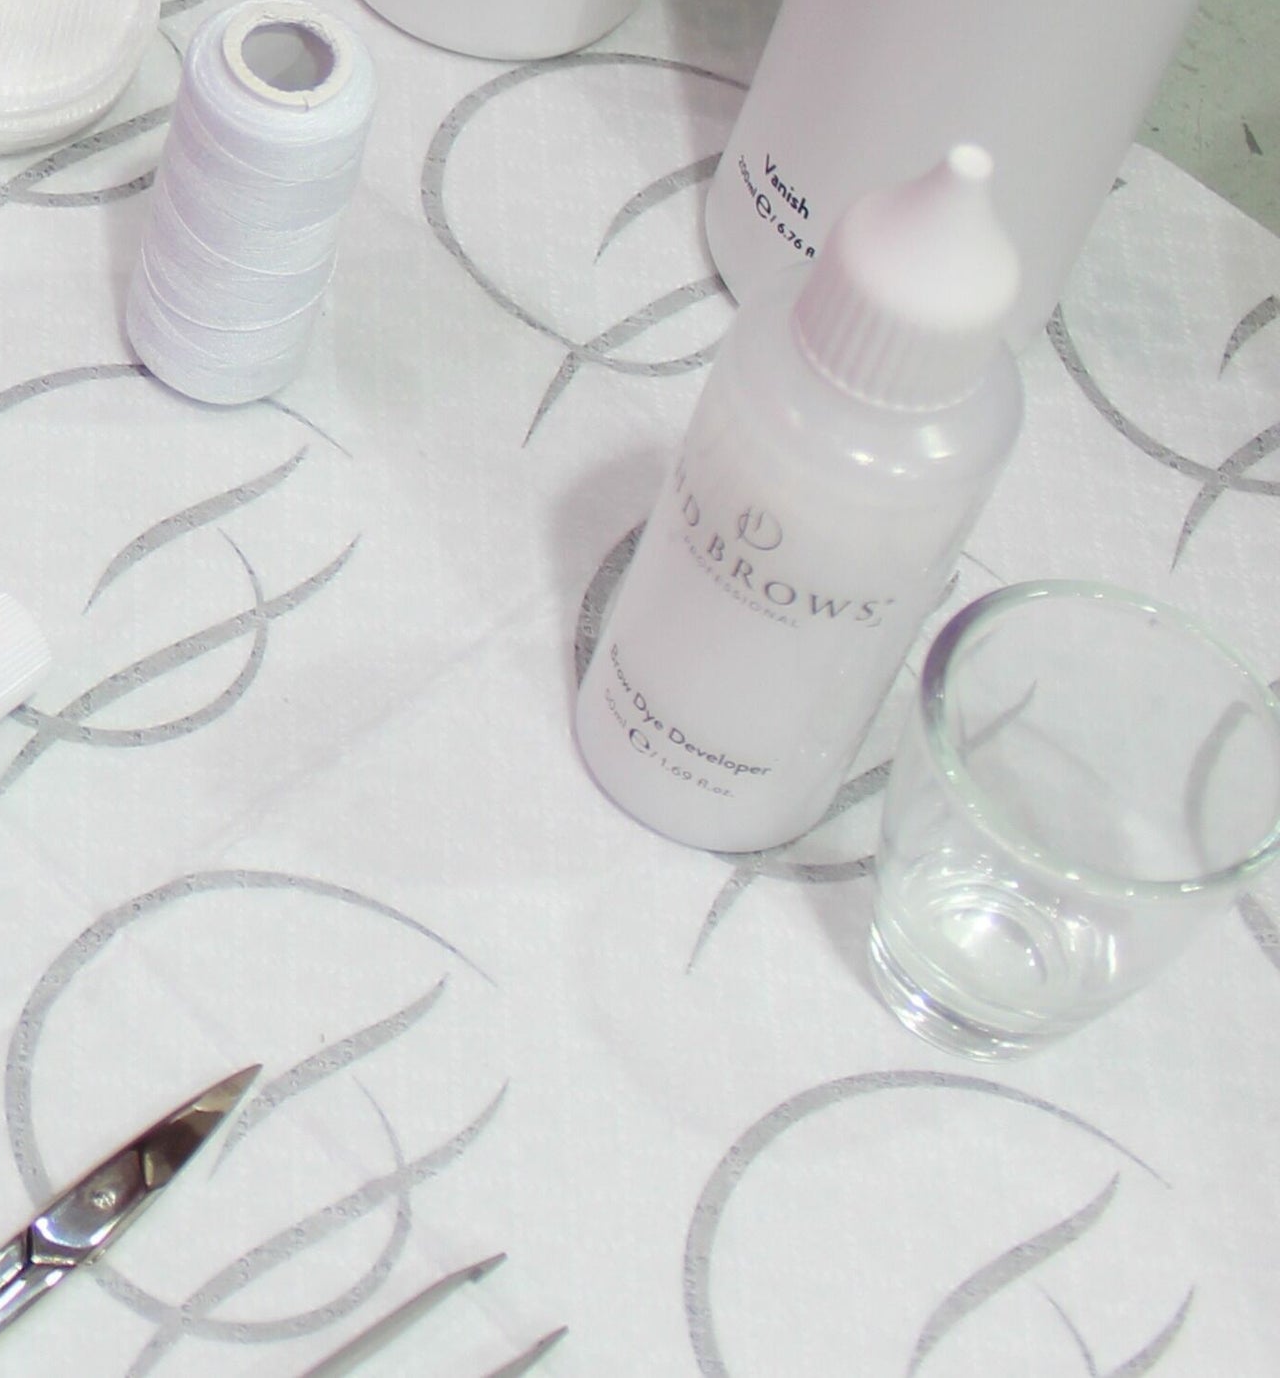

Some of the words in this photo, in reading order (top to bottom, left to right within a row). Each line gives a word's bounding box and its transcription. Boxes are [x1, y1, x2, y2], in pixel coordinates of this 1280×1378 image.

[765, 152, 810, 220] Vanish
[777, 222, 803, 250] 6.76
[610, 642, 631, 693] Brow
[632, 692, 665, 731] Dye
[668, 726, 772, 776] Developer
